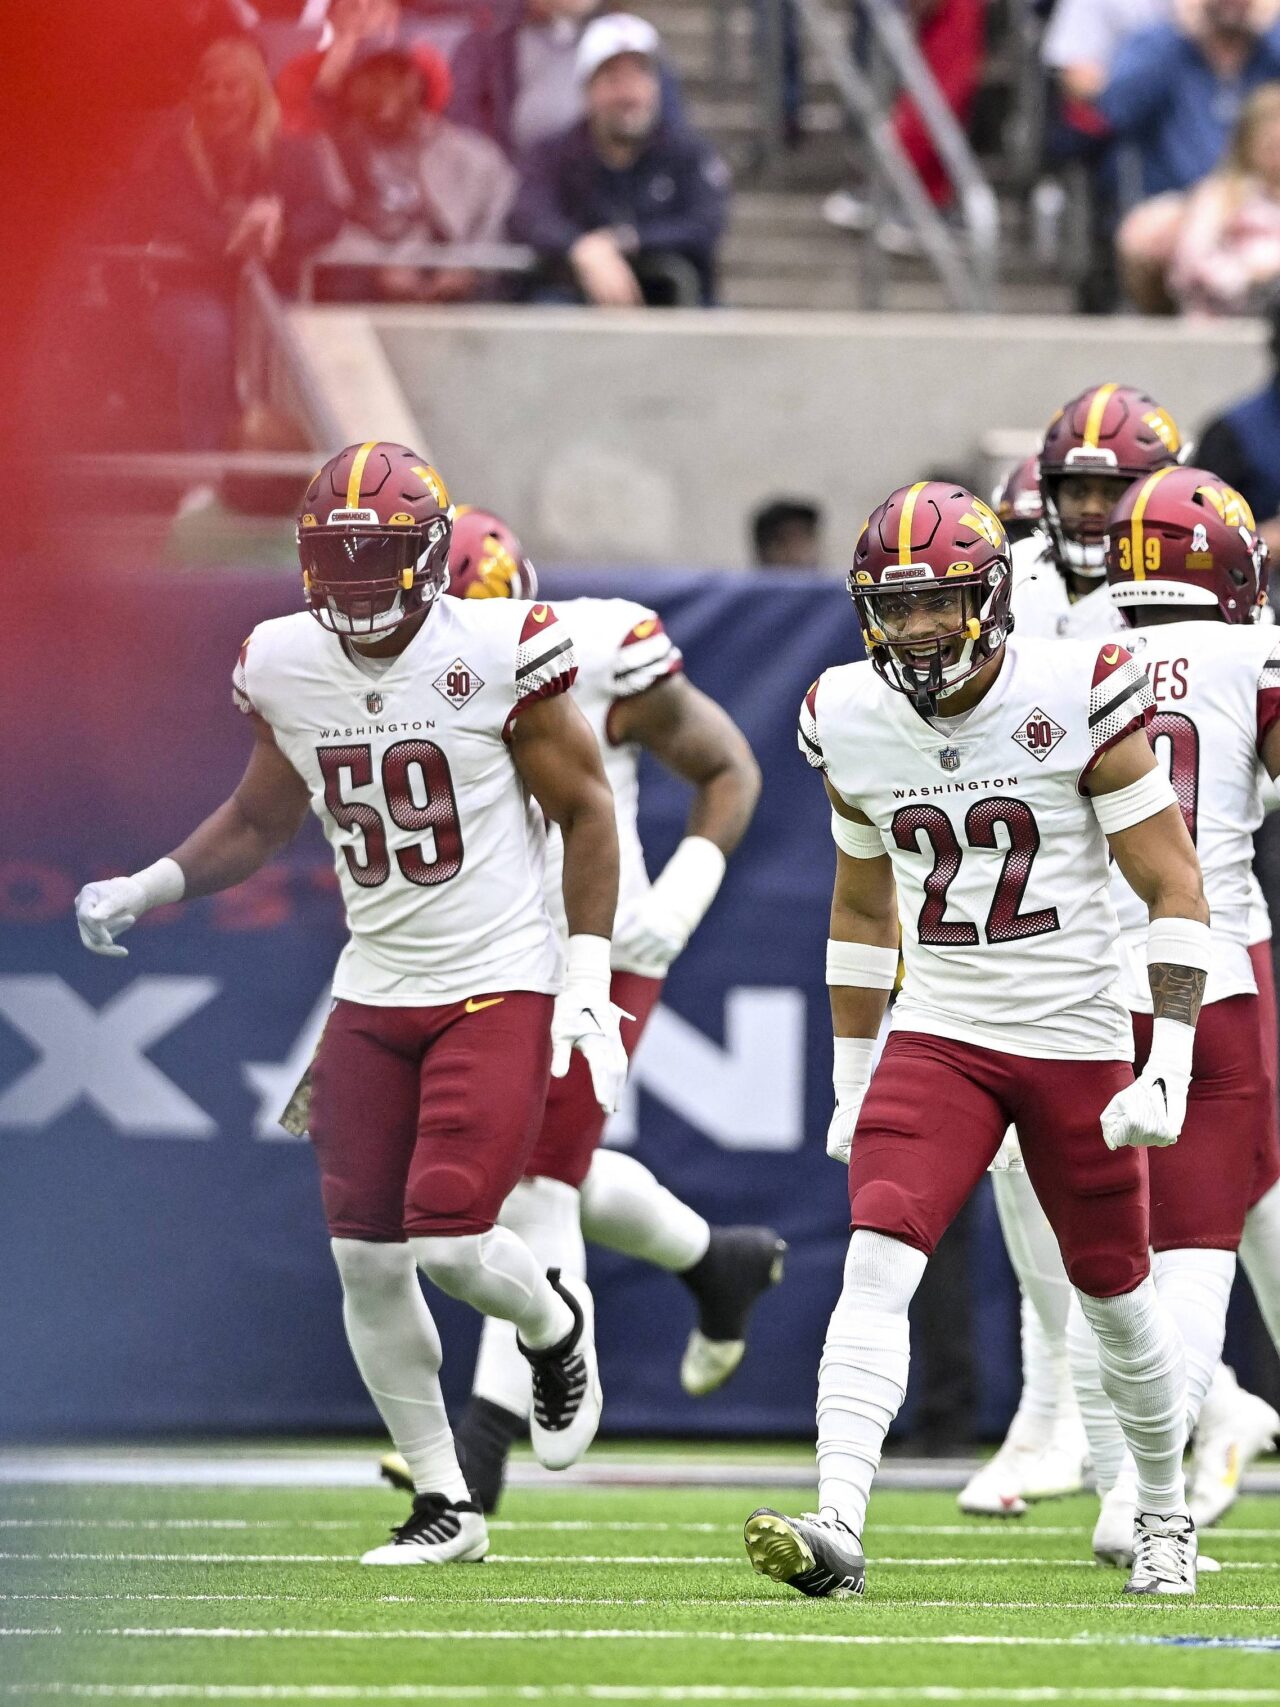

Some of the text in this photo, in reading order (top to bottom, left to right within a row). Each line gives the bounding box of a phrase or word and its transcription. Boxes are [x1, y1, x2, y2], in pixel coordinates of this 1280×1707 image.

[1118, 536, 1161, 572] 39
[1110, 590, 1185, 599] WASHINGTON
[446, 671, 471, 697] 90
[319, 720, 437, 740] WASHINGTON
[1026, 720, 1053, 749] 90
[892, 776, 1019, 800] WASHINGTON
[315, 738, 465, 889] 59
[890, 796, 1061, 947] 22
